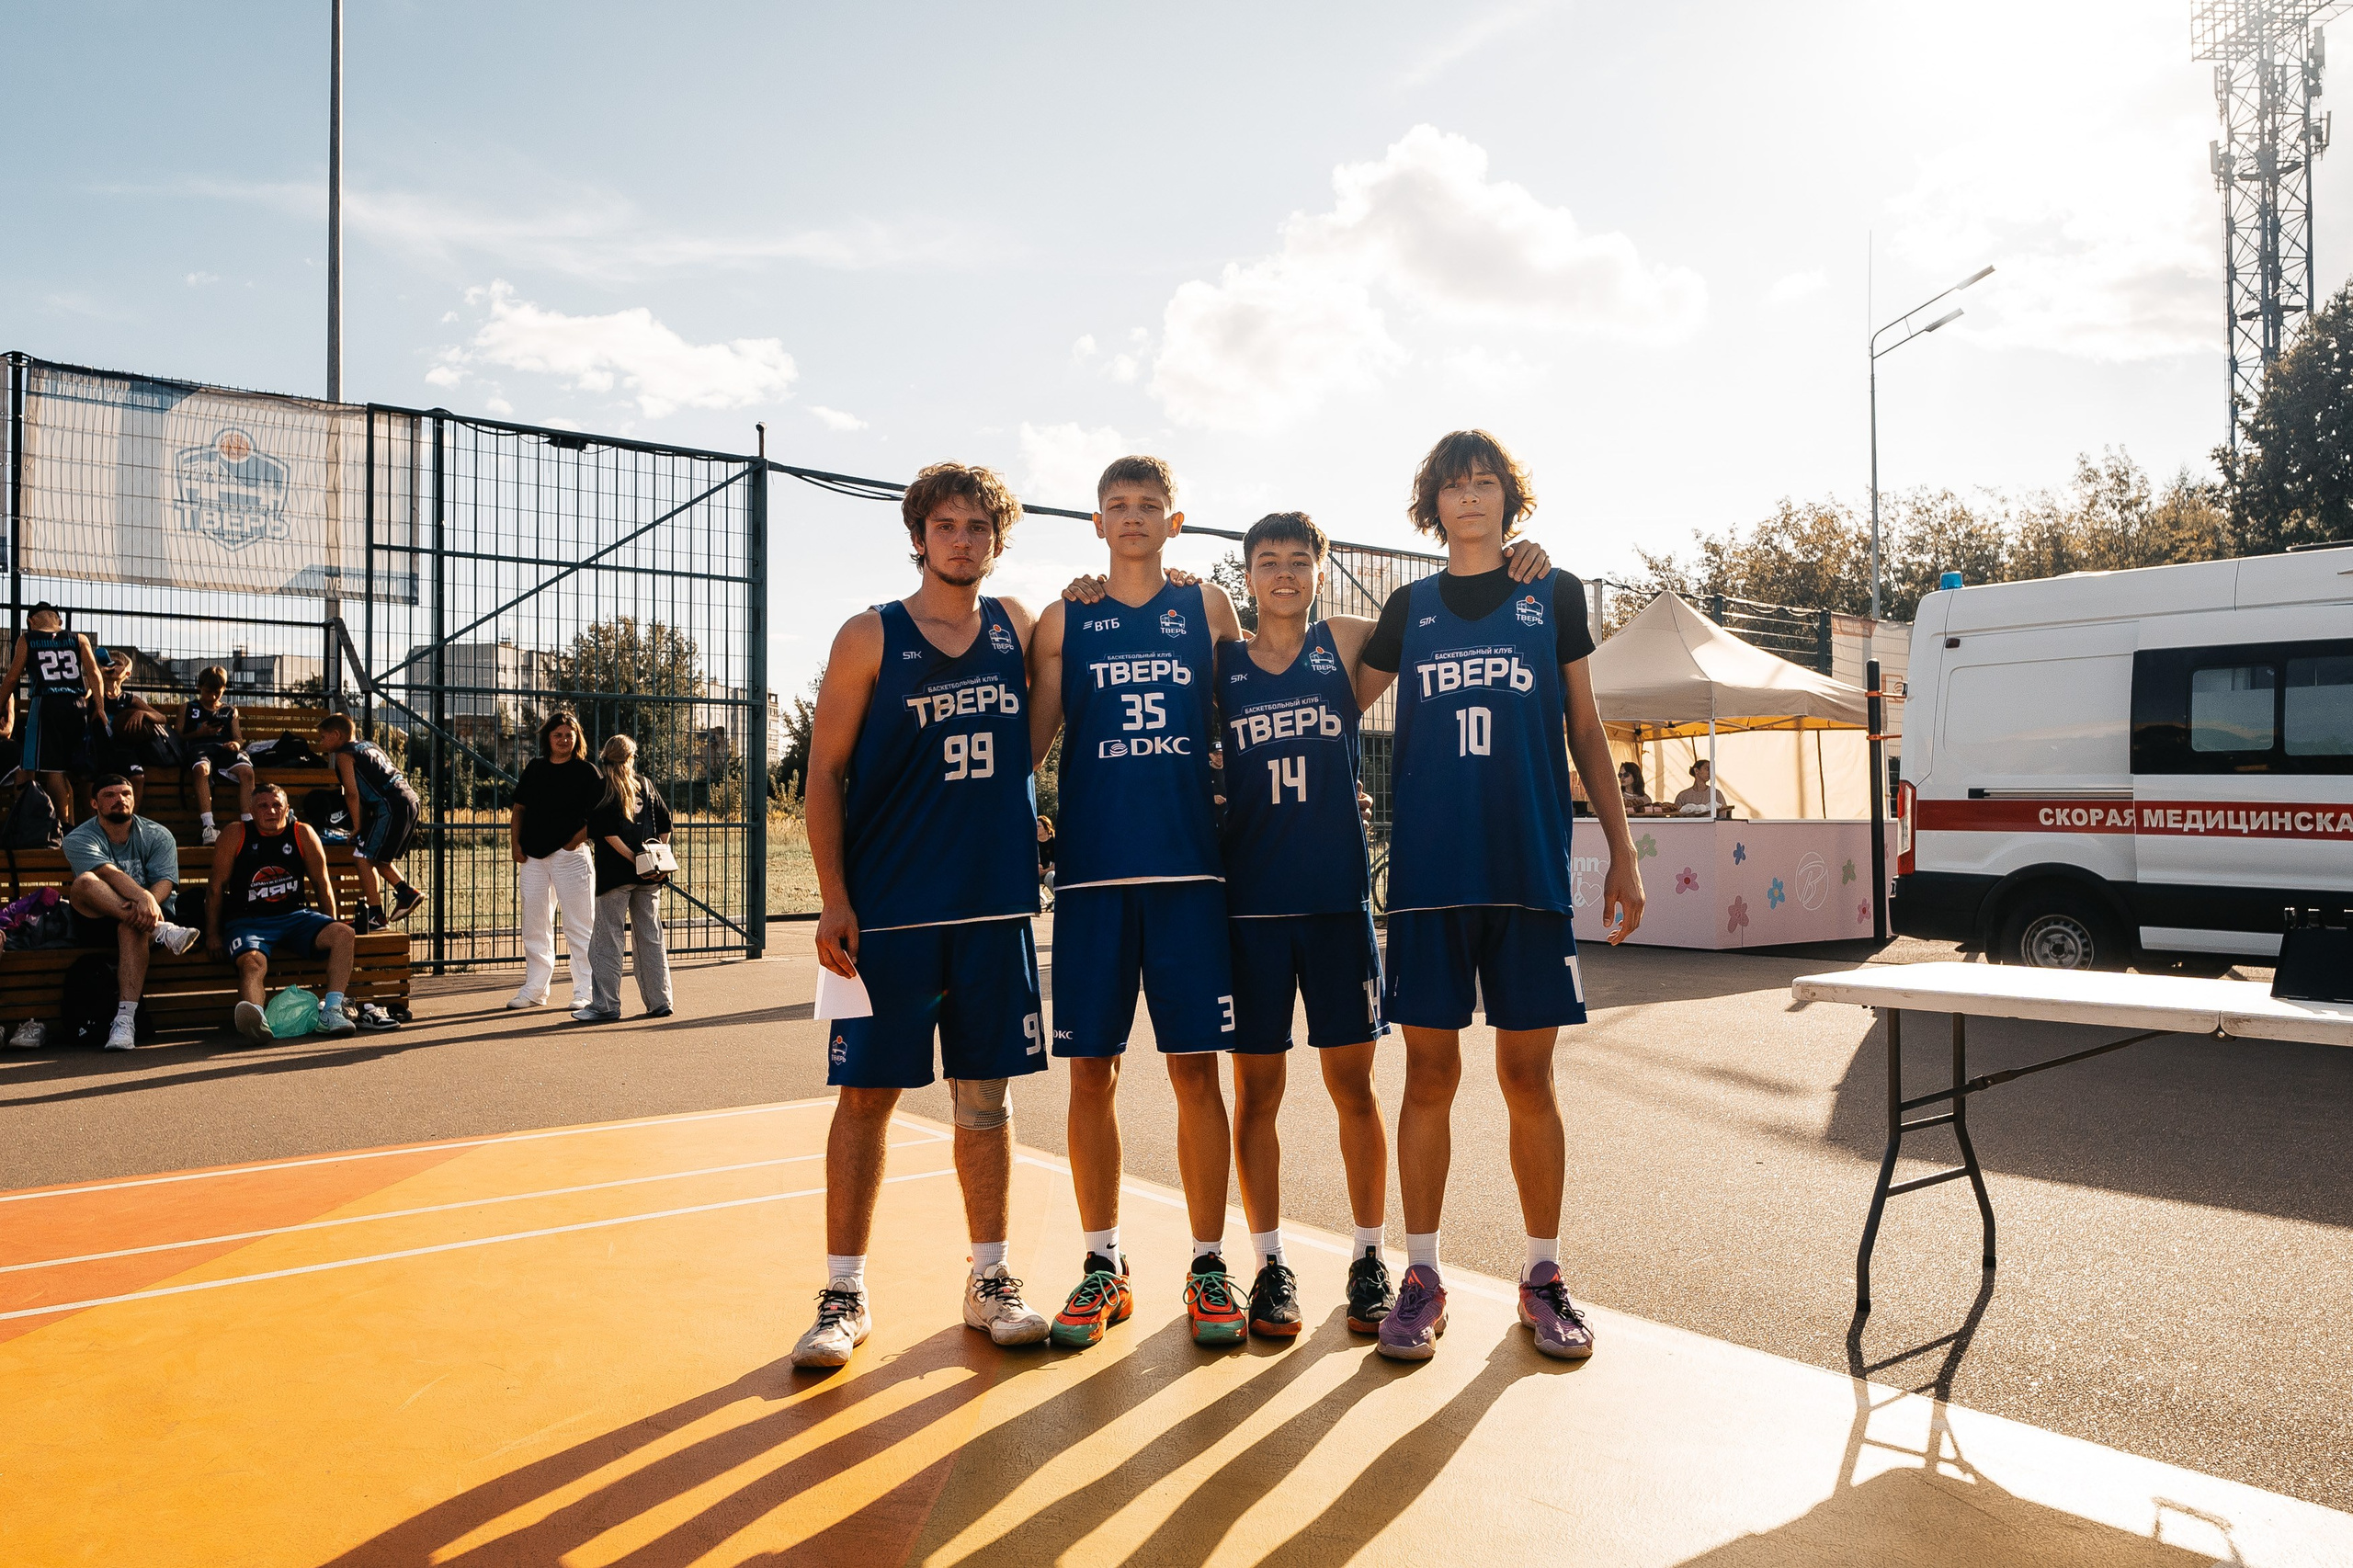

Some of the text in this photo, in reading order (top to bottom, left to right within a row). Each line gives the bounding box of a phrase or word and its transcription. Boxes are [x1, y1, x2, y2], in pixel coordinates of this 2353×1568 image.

[174, 501, 290, 540] ТВЕРЬ
[1095, 618, 1120, 631] ВТБ
[1419, 615, 1437, 627] STK
[1516, 613, 1543, 625] ТВЕРЬ
[1160, 627, 1187, 635] ТВЕРЬ
[903, 651, 922, 660] STK
[992, 642, 1014, 651] ТВЕРЬ
[1107, 652, 1155, 661] БАСКЕТБОЛЬНЫЙ
[1435, 646, 1492, 660] БАСКЕТБОЛЬНЫЙ
[38, 650, 80, 680] 23
[1089, 659, 1191, 688] ТВЕРЬ
[927, 676, 981, 692] БАСКЕТБОЛЬНЫЙ
[1231, 673, 1248, 684] STK
[1417, 657, 1533, 698] ТВЕРЬ
[191, 708, 200, 719] 3
[906, 684, 1019, 729] ТВЕРЬ
[1120, 692, 1166, 731] 35
[1245, 696, 1319, 715] БАСКЕТБОЛЬНЫЙ КЛУБ
[1230, 705, 1342, 751] ТВЕРЬ
[1456, 707, 1491, 757] 10
[1131, 736, 1191, 756] DKC
[944, 733, 994, 781] 99
[1267, 756, 1307, 804] 14
[331, 810, 344, 819] NIKE
[2039, 808, 2353, 833] СКОРАЯ МЕДИЦИНСКА
[248, 880, 299, 902] МЯЧ
[1218, 994, 1235, 1032] 3
[1023, 1012, 1046, 1055] 9
